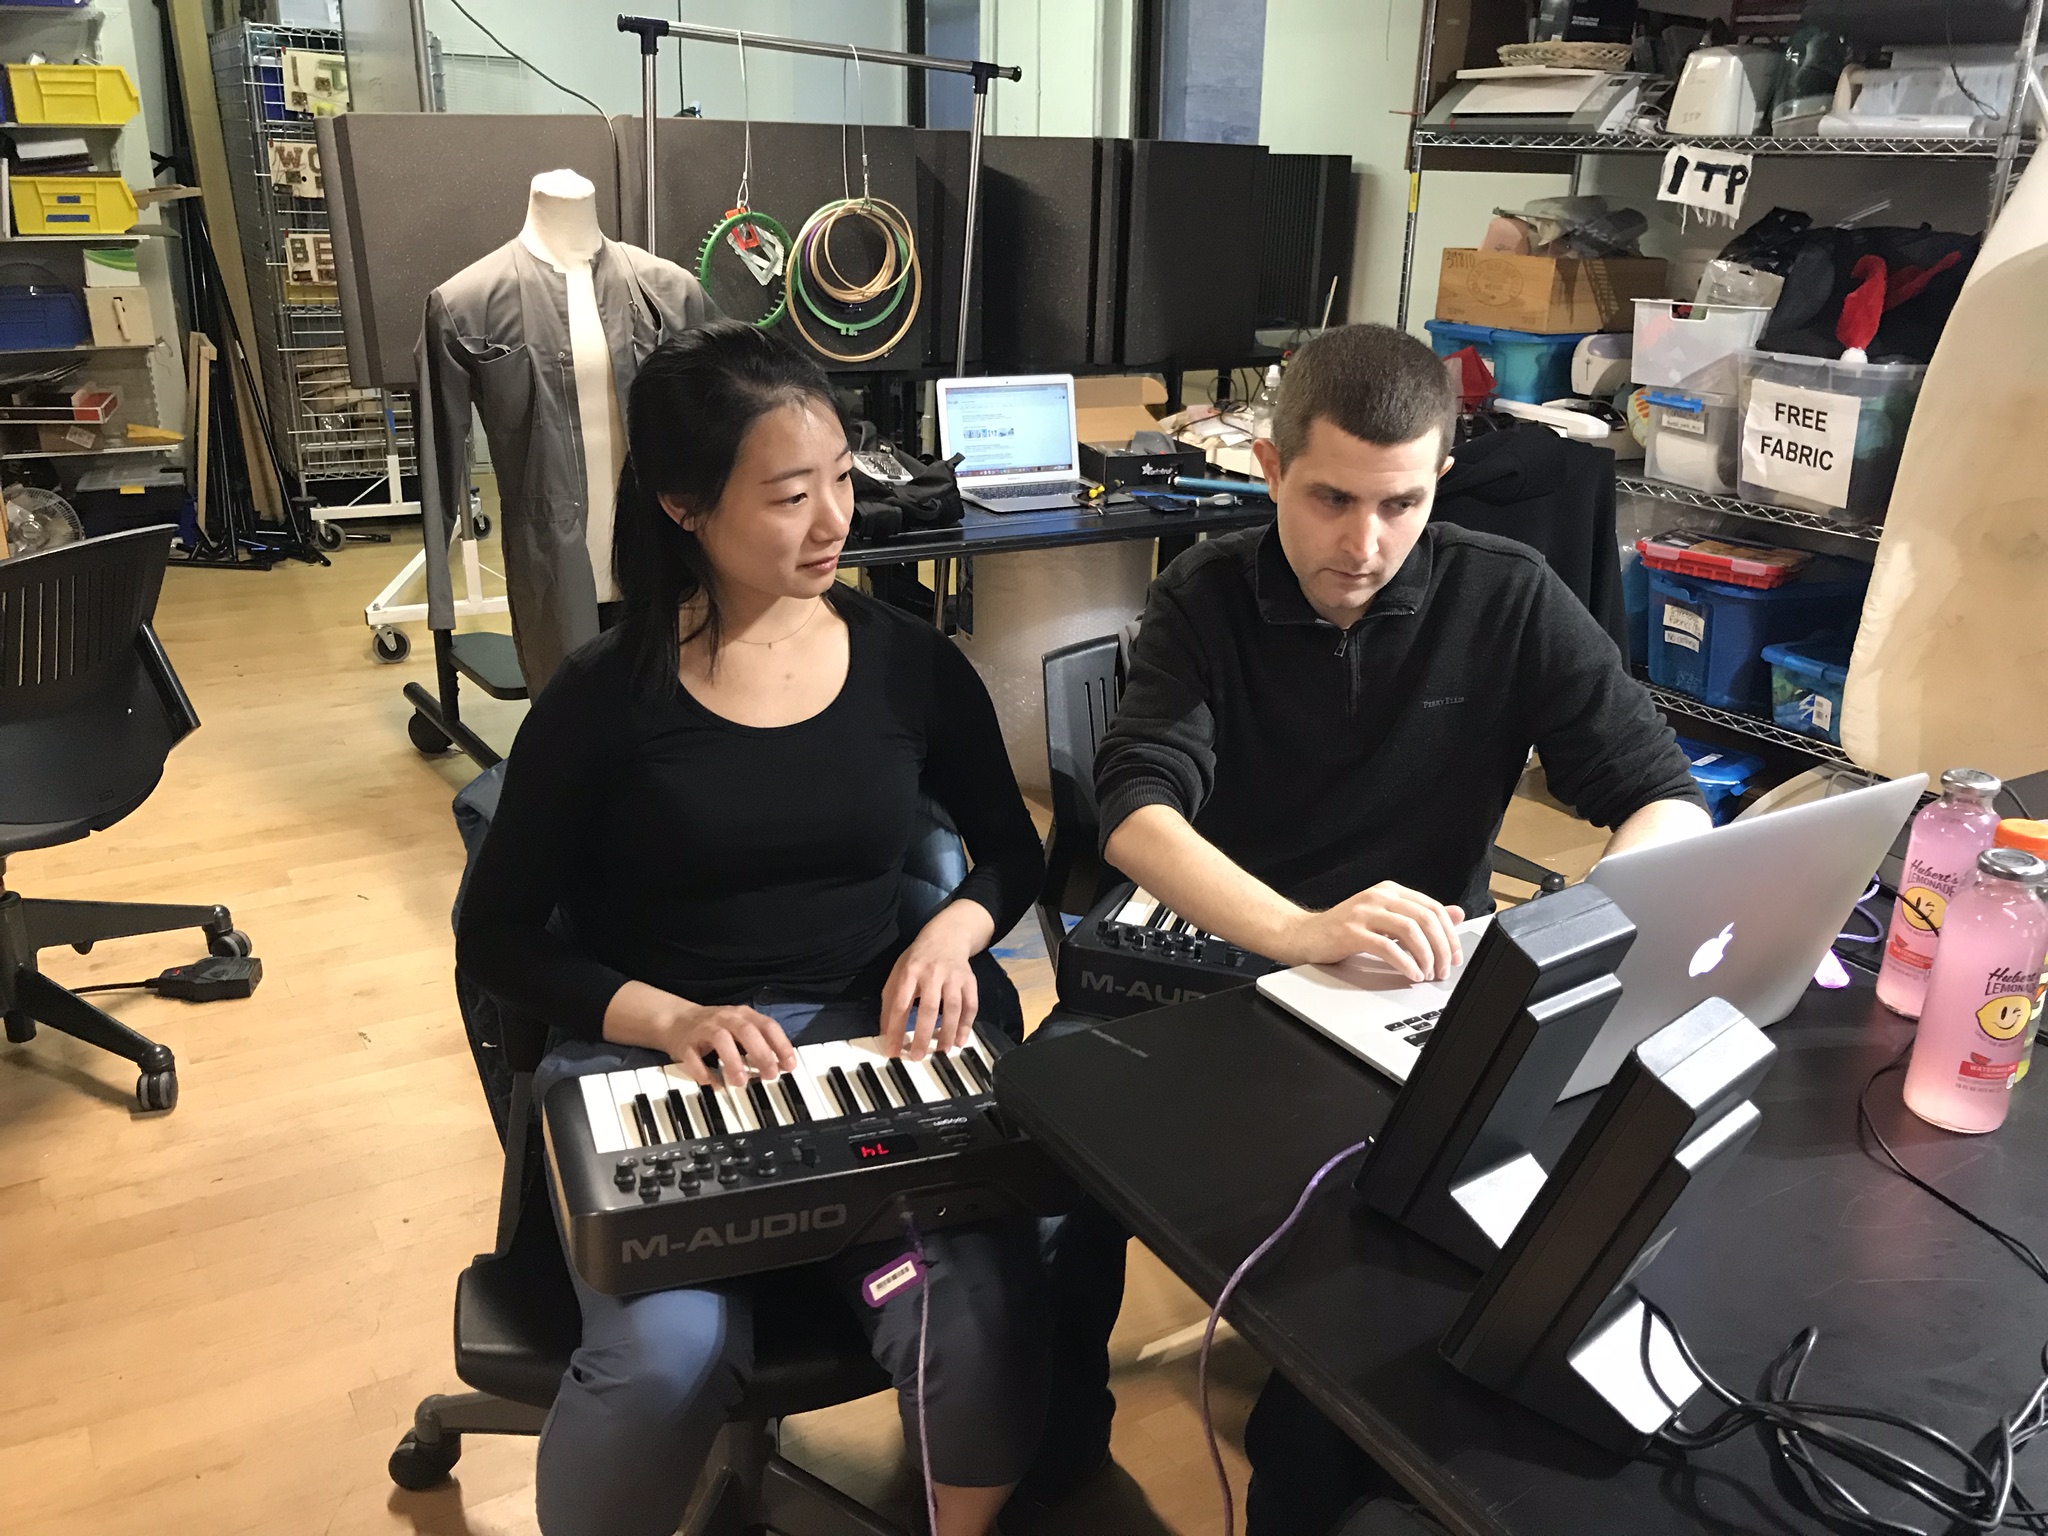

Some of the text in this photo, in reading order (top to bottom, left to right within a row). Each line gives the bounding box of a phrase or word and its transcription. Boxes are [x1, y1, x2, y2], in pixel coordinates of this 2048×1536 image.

[1667, 155, 1749, 205] ITP
[1774, 402, 1828, 432] FREE
[1760, 435, 1834, 471] FABRIC
[1907, 871, 1958, 897] LEMONADE
[1910, 859, 1959, 885] Hubert's
[621, 1204, 847, 1264] M-AUDIO
